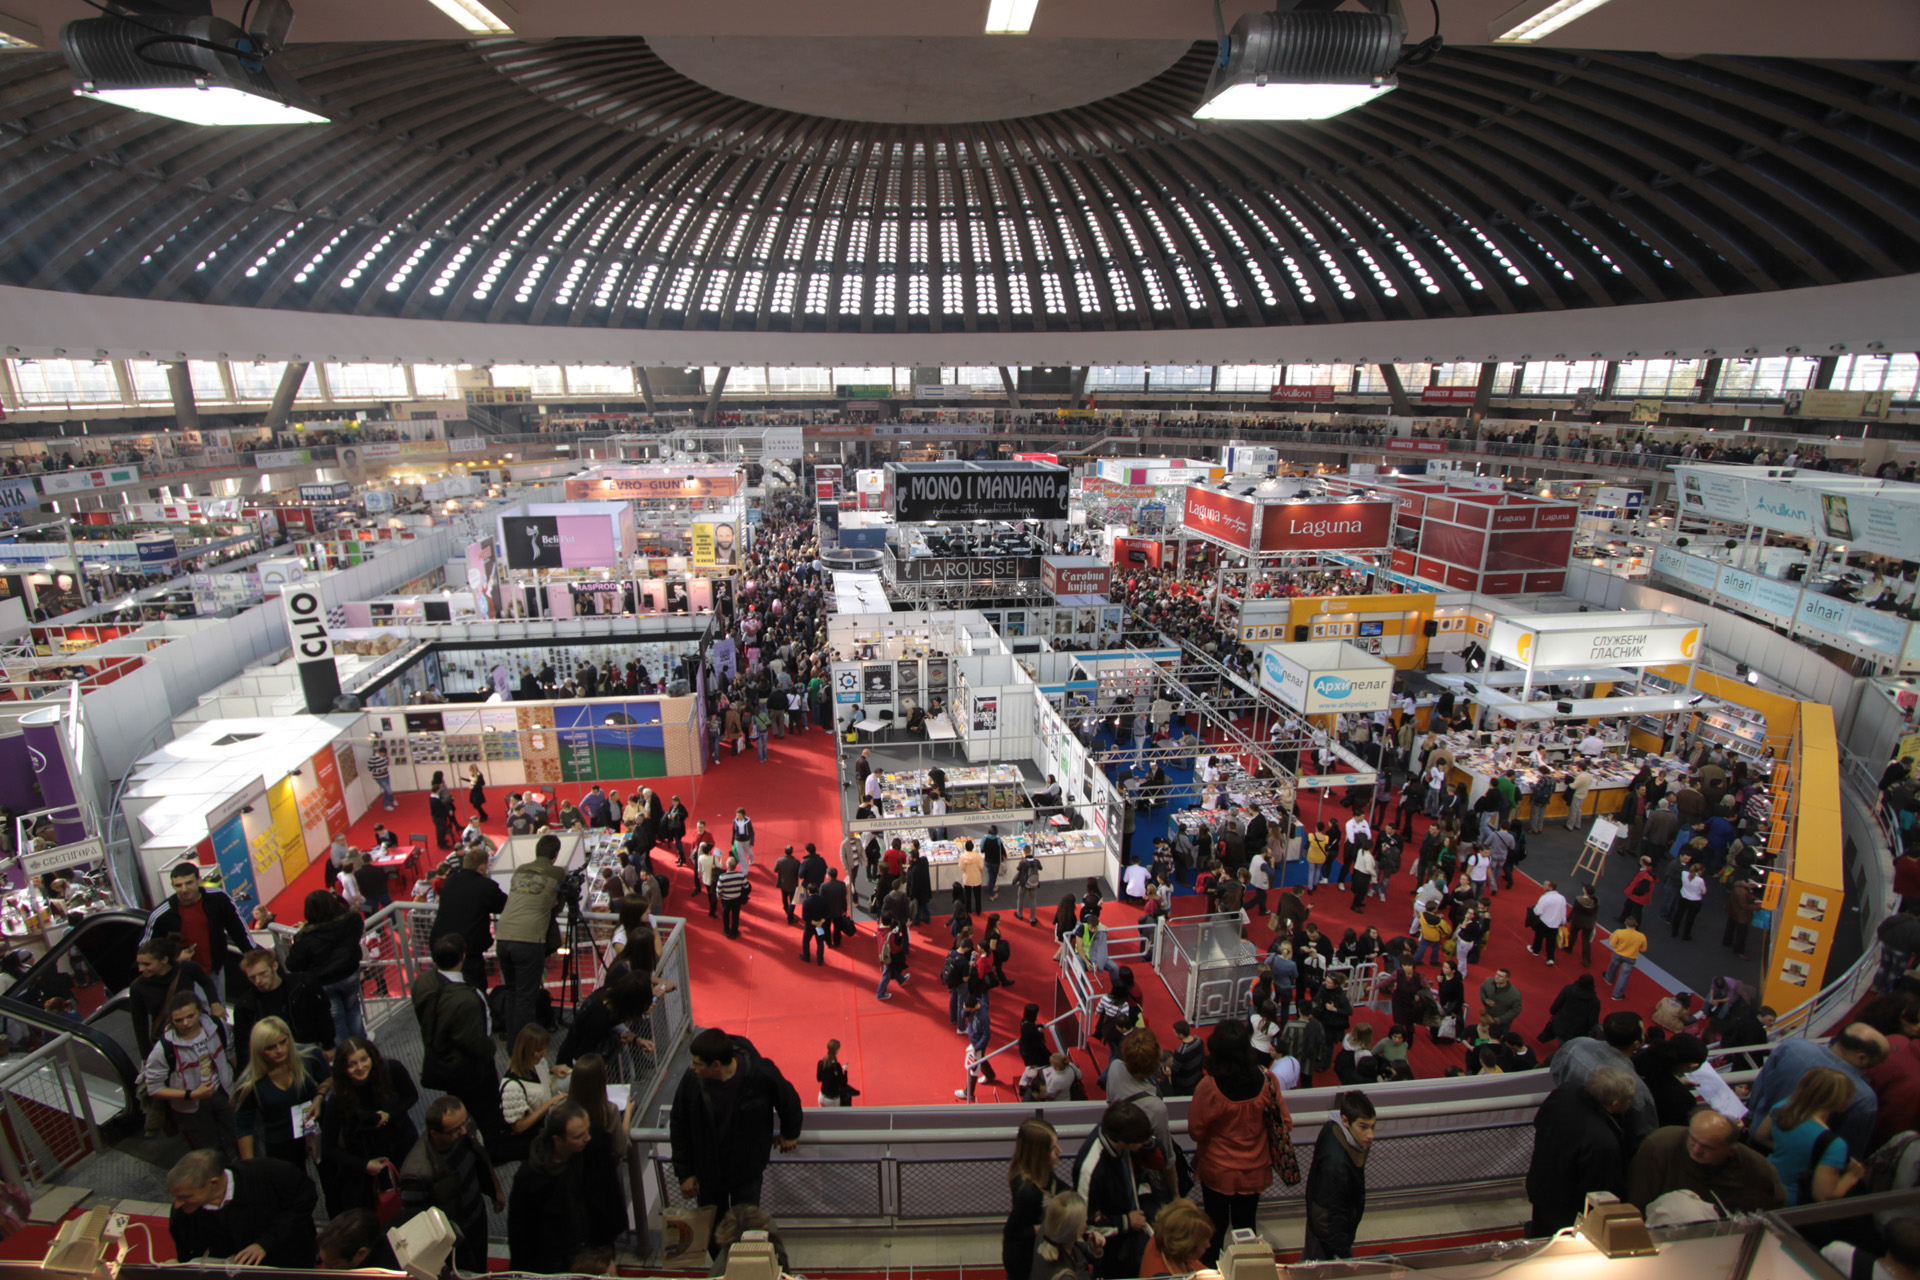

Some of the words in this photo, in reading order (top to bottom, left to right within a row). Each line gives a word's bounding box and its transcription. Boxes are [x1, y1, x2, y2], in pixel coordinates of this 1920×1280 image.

[1283, 389, 1311, 398] vulkan
[609, 479, 692, 491] EVRO-GIUNTI
[912, 476, 962, 500] MONO
[967, 476, 972, 499] I
[977, 475, 1055, 499] MANJANA
[1189, 500, 1220, 522] Laguna
[1542, 513, 1570, 522] Laguna
[1767, 503, 1807, 521] vulkan
[1498, 514, 1526, 523] Laguna
[1290, 519, 1362, 537] Laguna
[542, 535, 559, 544] Beli
[560, 535, 575, 544] Put
[1126, 540, 1152, 549] Laguna
[1660, 552, 1682, 568] alnari
[923, 561, 1015, 577] LAROUSSE
[1061, 569, 1105, 582] Čarobna
[1067, 582, 1098, 594] knjiga
[1724, 573, 1752, 592] alnari
[1806, 600, 1844, 622] alnari
[290, 592, 328, 658] CLIO
[1593, 634, 1647, 646] СЛУЖБЕНИ
[1590, 646, 1644, 660] ГЛАСНИК
[1315, 679, 1387, 695] Архипелаг
[1318, 700, 1377, 709] www.arhipelag.rs
[870, 820, 897, 828] FABRIKA
[964, 814, 991, 822] FABRIKA
